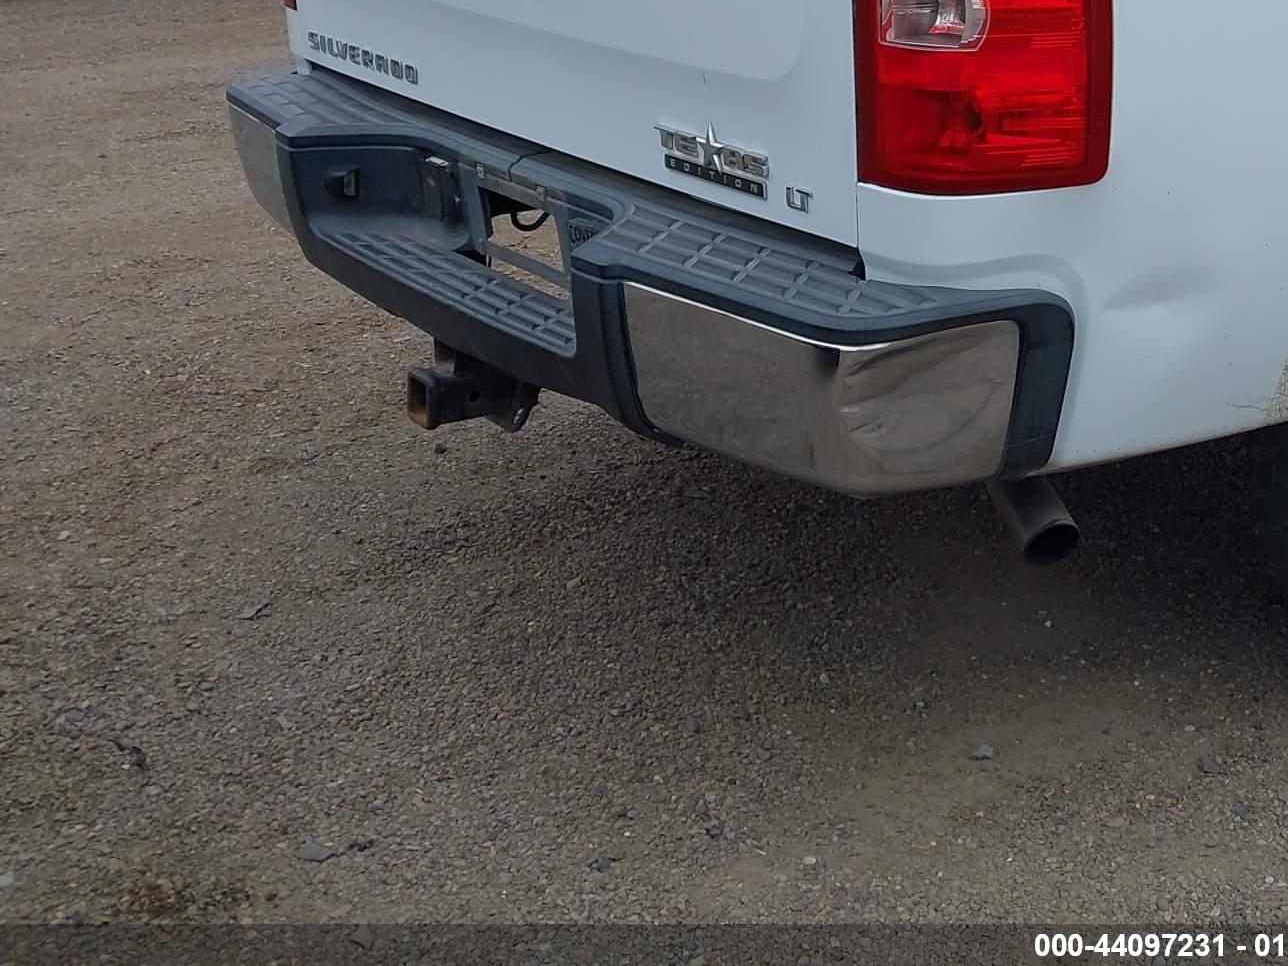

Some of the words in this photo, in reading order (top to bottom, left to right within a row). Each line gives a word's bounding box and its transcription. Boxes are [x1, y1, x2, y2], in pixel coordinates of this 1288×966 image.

[307, 31, 419, 86] SILVERADO
[669, 156, 759, 195] EDITION
[785, 185, 814, 214] LT
